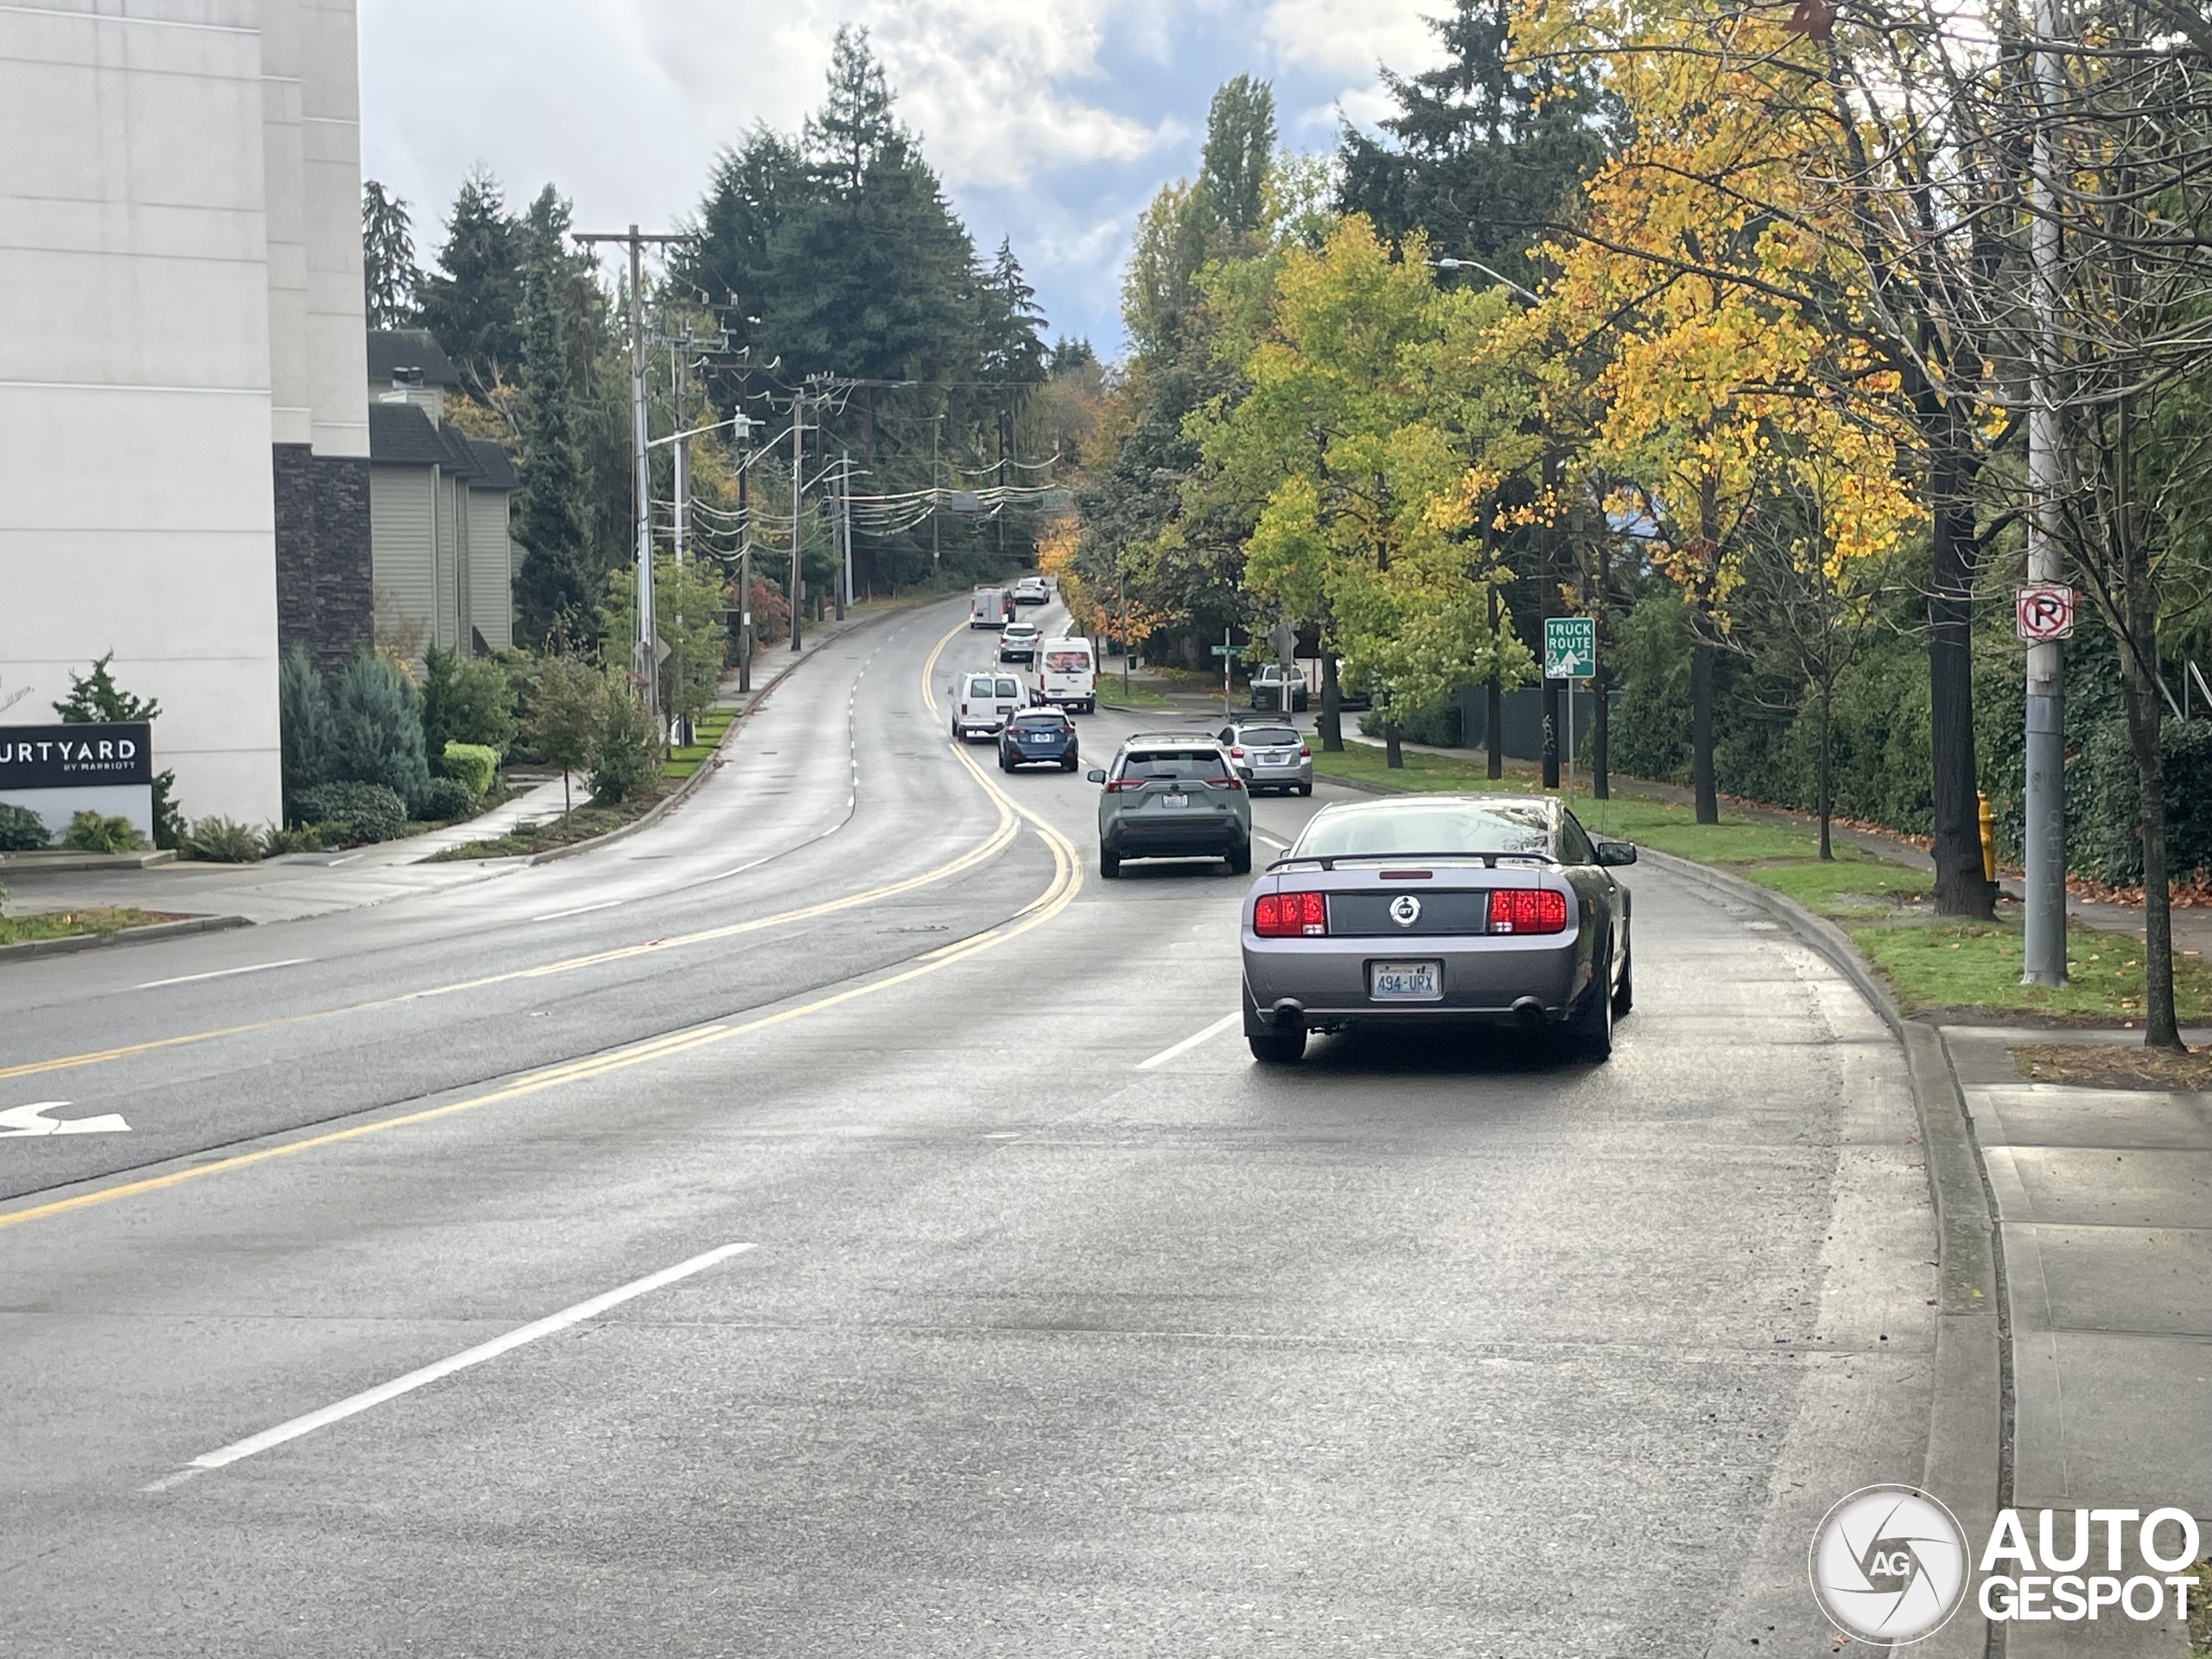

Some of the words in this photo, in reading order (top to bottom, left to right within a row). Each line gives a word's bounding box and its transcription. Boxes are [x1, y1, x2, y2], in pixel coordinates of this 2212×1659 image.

[2035, 599, 2057, 626] P
[1548, 623, 1591, 636] TRUCK
[1548, 637, 1591, 649] ROUTE
[64, 763, 76, 772] BY
[81, 761, 136, 771] MARRIOTT
[1378, 976, 1433, 992] 494-URX
